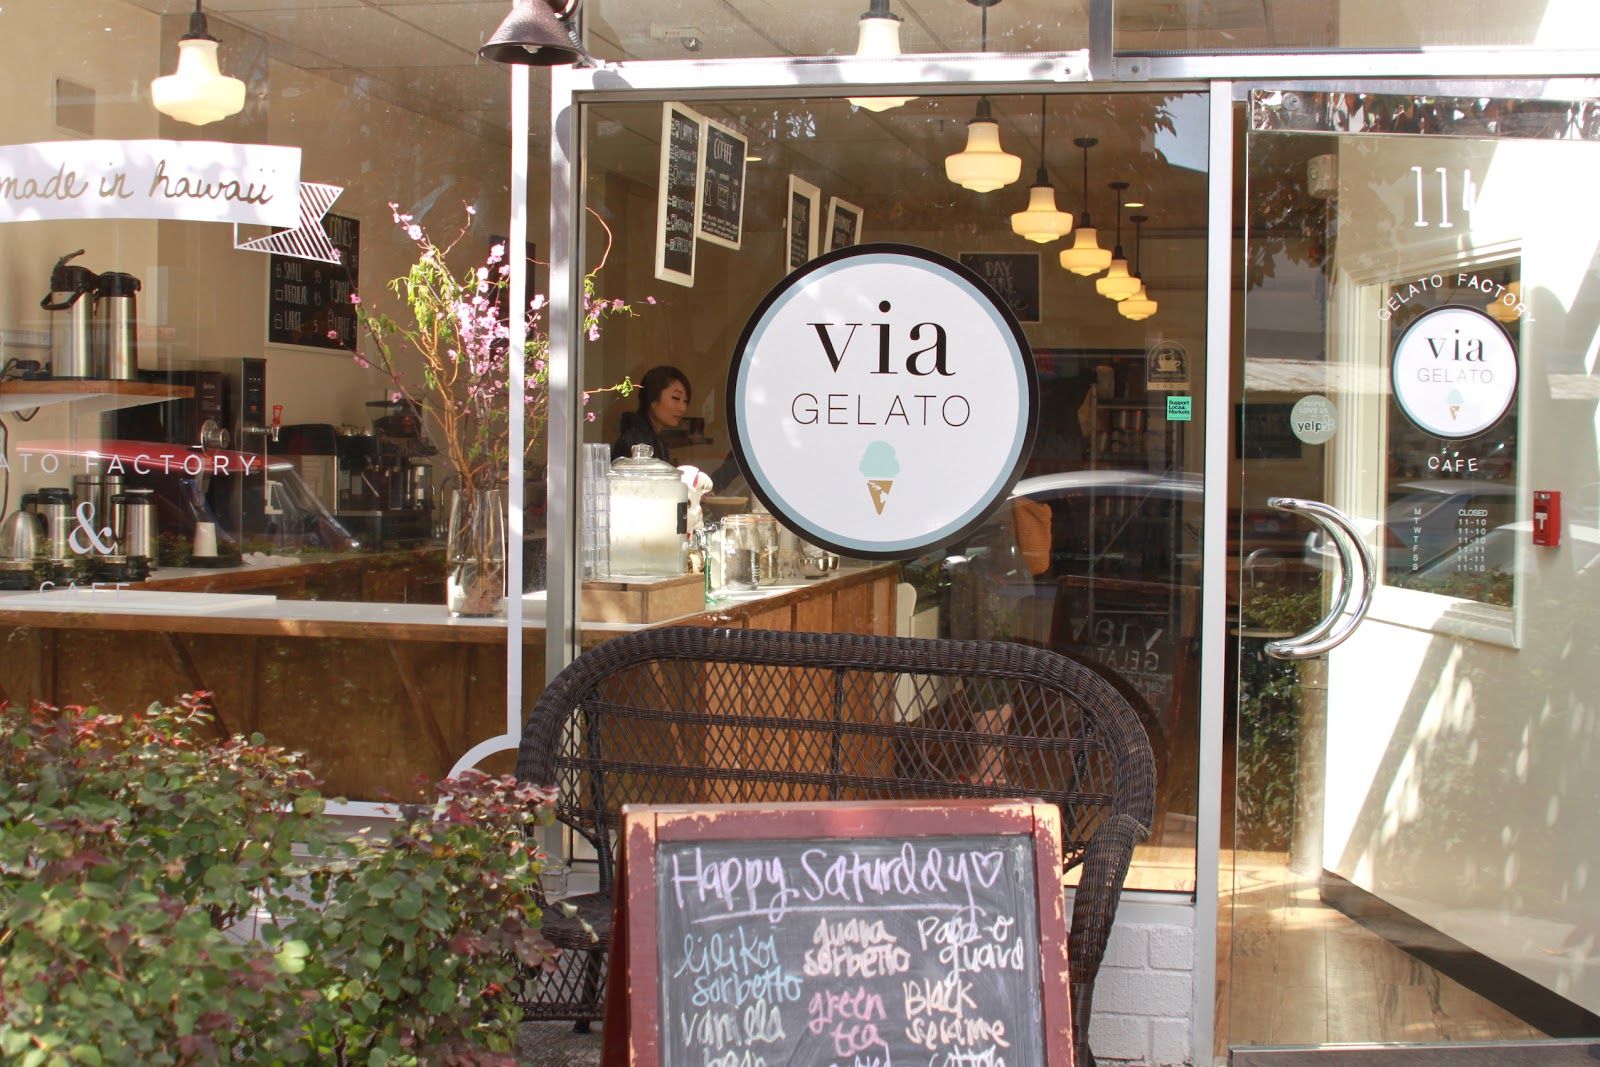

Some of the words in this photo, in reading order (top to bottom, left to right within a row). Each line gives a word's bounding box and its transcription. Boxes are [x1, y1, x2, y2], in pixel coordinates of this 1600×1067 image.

[714, 138, 734, 166] COFFEE
[0, 161, 88, 200] made
[99, 162, 134, 199] in
[148, 159, 274, 205] hawaii
[1378, 274, 1444, 321] GELATO
[1457, 273, 1536, 322] FACTORY
[806, 300, 956, 376] via
[1424, 329, 1488, 362] via
[1416, 367, 1494, 384] GELATO
[792, 392, 970, 427] GELATO
[1297, 420, 1322, 432] yelp
[86, 452, 258, 476] FACTORY
[1428, 456, 1479, 472] CAFE
[68, 501, 118, 556] &
[1458, 509, 1488, 517] CLOSED
[672, 847, 798, 923] Happy
[801, 842, 987, 938] Saturday
[813, 917, 896, 948] guava
[804, 944, 910, 978] sorbetto
[692, 964, 804, 1008] sorbetto
[903, 978, 978, 1020] Black
[682, 998, 786, 1050] vanilla
[809, 986, 887, 1034] green
[830, 1022, 888, 1058] tea
[906, 1016, 1010, 1050] sesame
